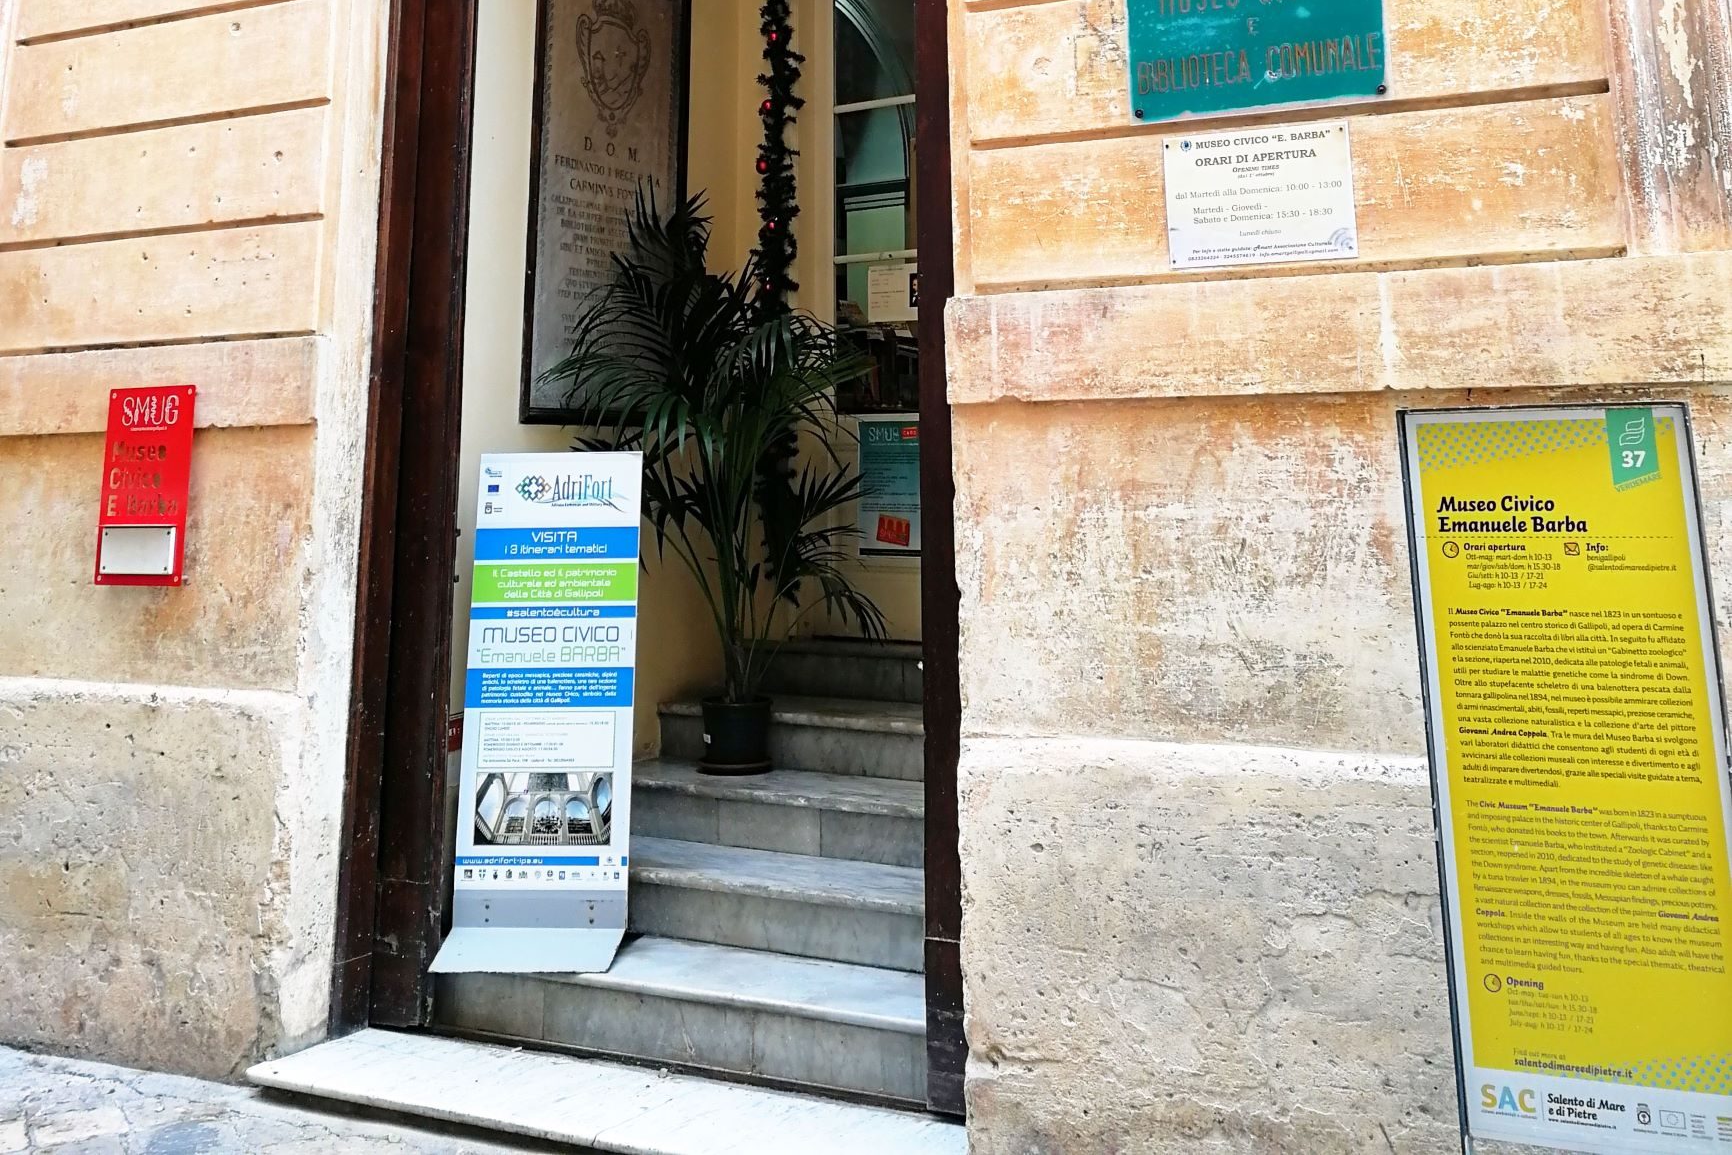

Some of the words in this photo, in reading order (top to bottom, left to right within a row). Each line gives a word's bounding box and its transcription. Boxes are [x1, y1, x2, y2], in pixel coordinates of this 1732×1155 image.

[1246, 16, 1259, 35] E
[1136, 47, 1253, 96] BIBLIOTECA
[1264, 31, 1382, 81] COMUNALE
[1195, 139, 1230, 149] MUSEO
[1233, 135, 1268, 146] CIVICO
[1290, 129, 1330, 140] BARBA”
[1195, 155, 1231, 167] ORARI
[1235, 153, 1249, 163] DI
[1251, 147, 1316, 162] APERTURA
[1175, 191, 1187, 200] dal
[1222, 188, 1236, 196] alla
[1239, 184, 1282, 195] Domenica:
[1286, 182, 1308, 191] 10:00
[1317, 179, 1342, 189] 13:00
[1193, 215, 1220, 224] Sabato
[1229, 212, 1273, 222] Domenica:
[1276, 210, 1299, 218] 15:30
[1308, 207, 1332, 216] 18:30
[121, 394, 179, 426] SMUG
[111, 439, 166, 462] Museo
[1621, 450, 1645, 467] 37
[109, 466, 161, 488] Civico
[551, 474, 613, 501] AdriFort
[125, 492, 178, 516] Barba
[1435, 495, 1497, 512] Museo
[1499, 495, 1555, 512] Civico
[1437, 516, 1527, 533] Emanuele
[1531, 516, 1588, 533] Barba
[530, 531, 577, 543] VISITA
[510, 544, 517, 554] 3
[565, 543, 607, 554] tematici
[1487, 543, 1526, 552] apertura
[1585, 543, 1609, 552] Info:
[500, 568, 541, 577] Castello
[543, 568, 555, 576] ed
[565, 567, 616, 578] patrimonio
[497, 579, 541, 588] culturale
[544, 579, 556, 587] ed
[559, 578, 611, 588] ambientale
[503, 590, 528, 598] della
[554, 589, 562, 597] di
[564, 588, 603, 599] Gallipoli
[482, 626, 556, 643] MUSEO
[562, 625, 619, 642] CIVICO
[1458, 726, 1489, 734] Giovanni
[1490, 728, 1516, 736] Andrea
[1518, 729, 1549, 739] Coppola.
[1605, 733, 1631, 742] Museo
[1632, 735, 1654, 743] Barba
[1663, 736, 1698, 747] svolgono
[462, 857, 543, 865] www.adrifort-ipa.eu
[1506, 976, 1544, 990] Opening
[1514, 1056, 1632, 1079] salentodimareedipietre.it
[1480, 1083, 1535, 1113] SAC
[1547, 1093, 1583, 1107] Salento
[1586, 1098, 1595, 1108] di
[1597, 1099, 1625, 1113] Mare
[1548, 1107, 1554, 1115] e
[1555, 1106, 1565, 1116] di
[1567, 1107, 1597, 1121] Pietre
